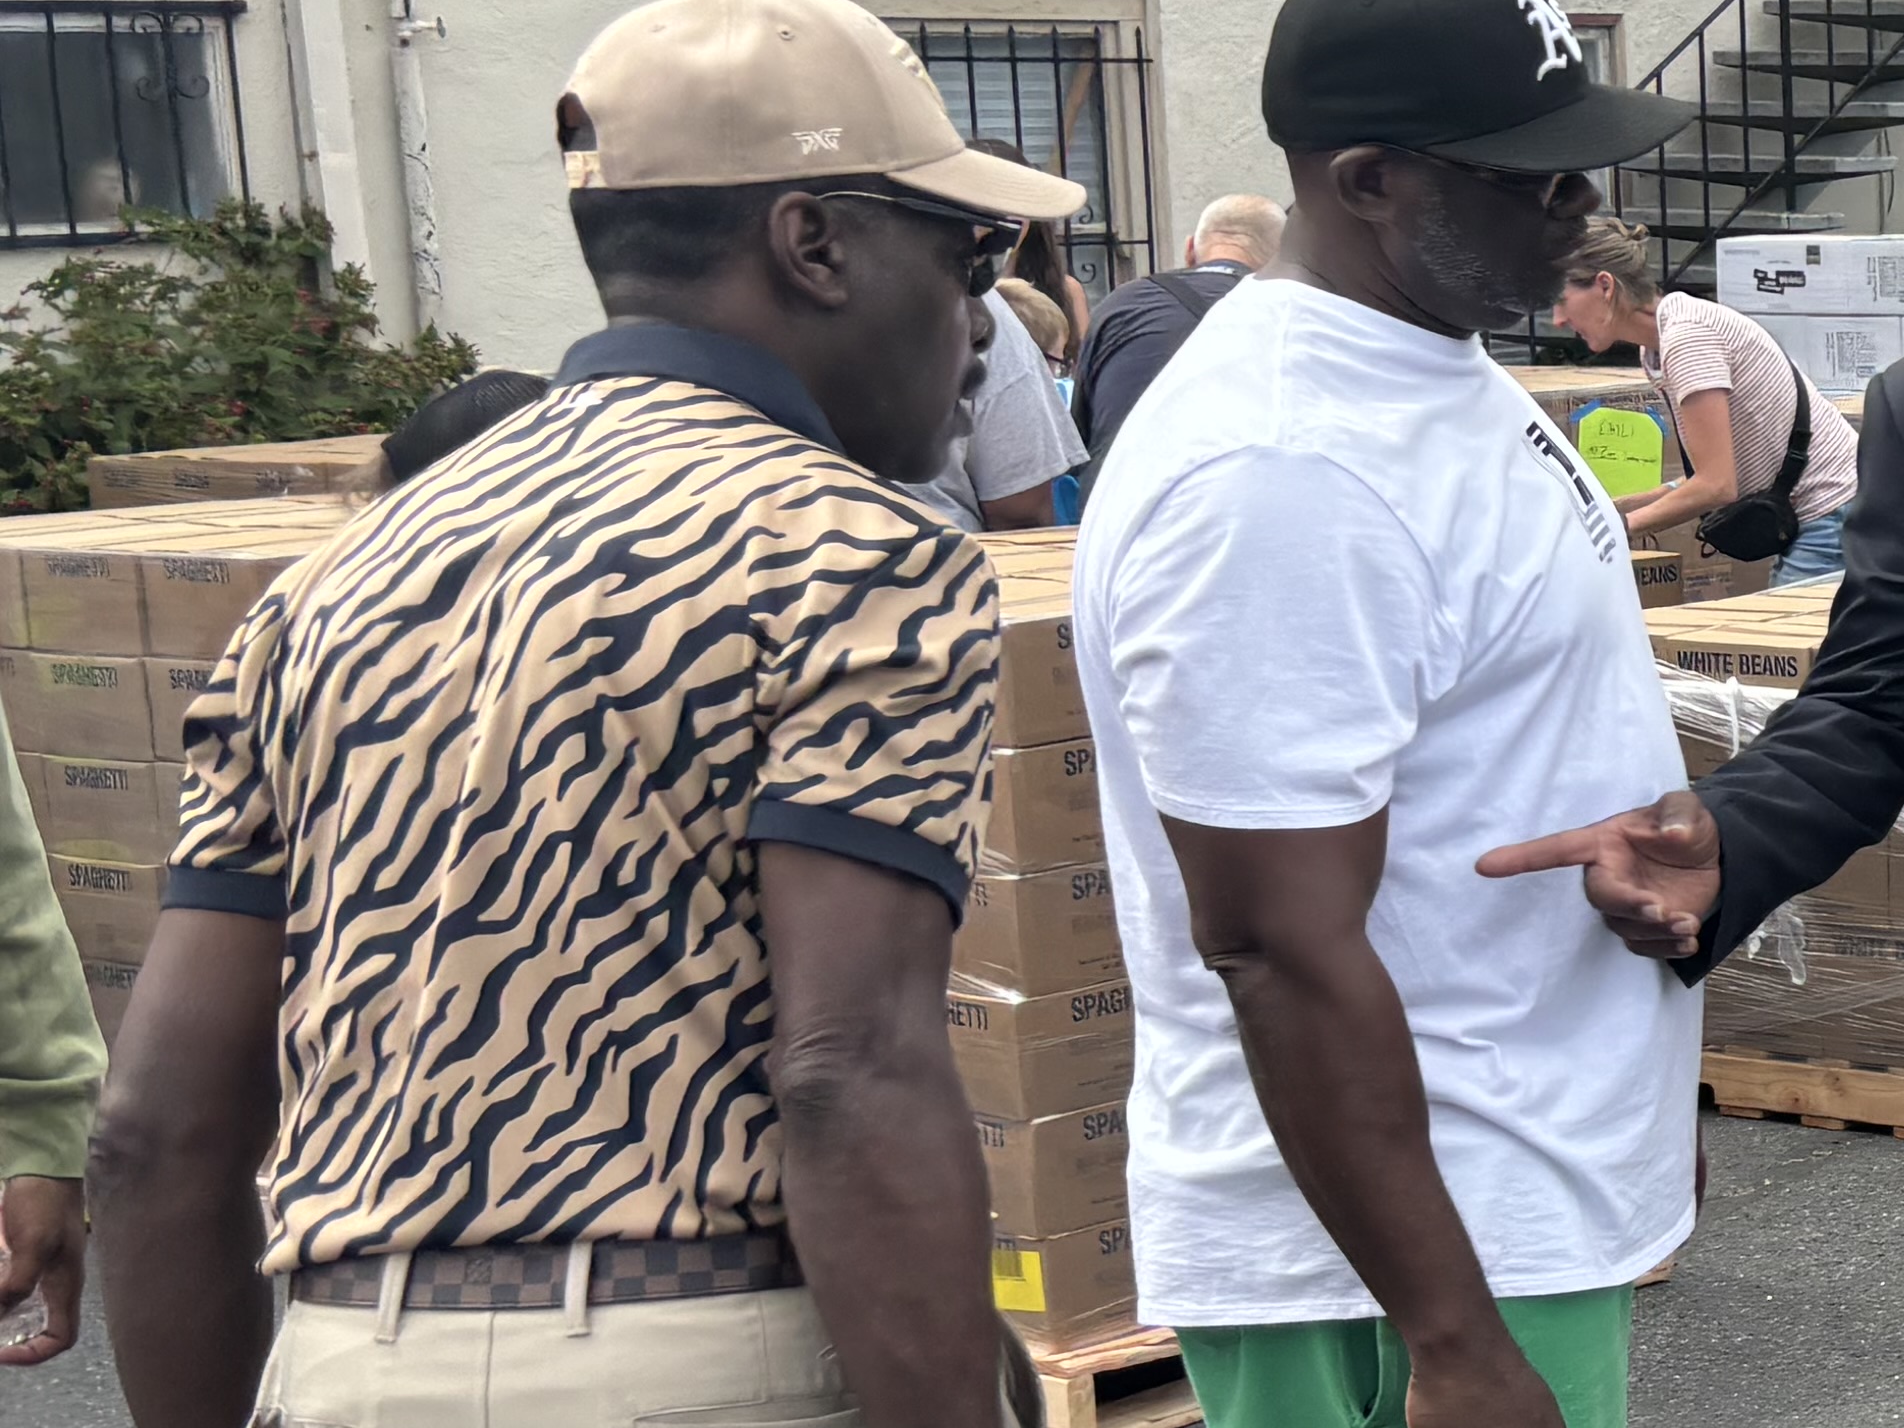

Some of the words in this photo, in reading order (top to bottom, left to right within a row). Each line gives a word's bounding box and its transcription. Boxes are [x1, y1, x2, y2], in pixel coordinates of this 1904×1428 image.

[1641, 564, 1678, 586] EANS
[1677, 650, 1733, 675] WHITE
[1739, 653, 1798, 678] BEANS
